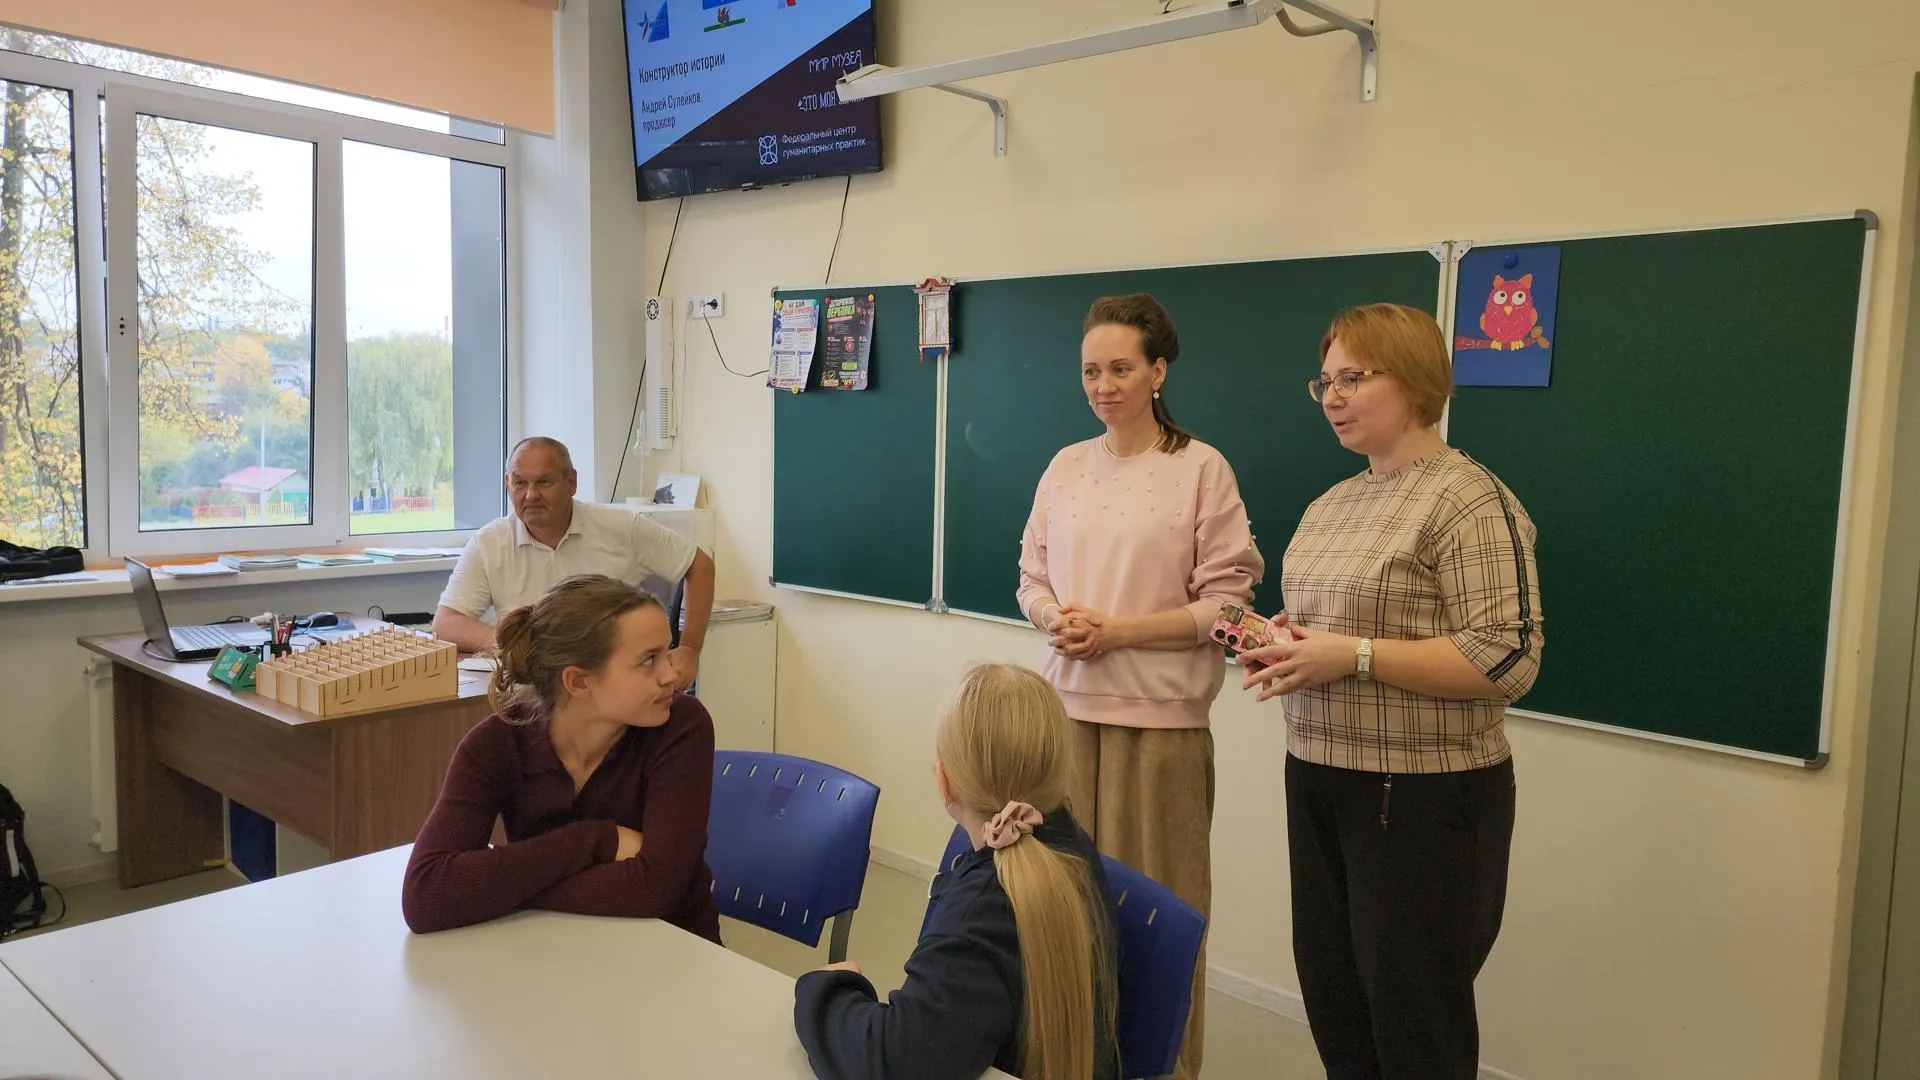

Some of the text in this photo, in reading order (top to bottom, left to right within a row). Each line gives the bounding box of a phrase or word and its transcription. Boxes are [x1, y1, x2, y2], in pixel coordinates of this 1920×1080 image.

[638, 53, 726, 84] Конструктор истории
[808, 49, 862, 73] МИР МУЗЕЯ
[641, 91, 701, 114] Андрей Сулейков
[820, 91, 836, 108] МОЯ
[642, 116, 676, 133] продюсер
[781, 125, 857, 144] Федеральный центр
[782, 138, 867, 159] гуманитарных практик
